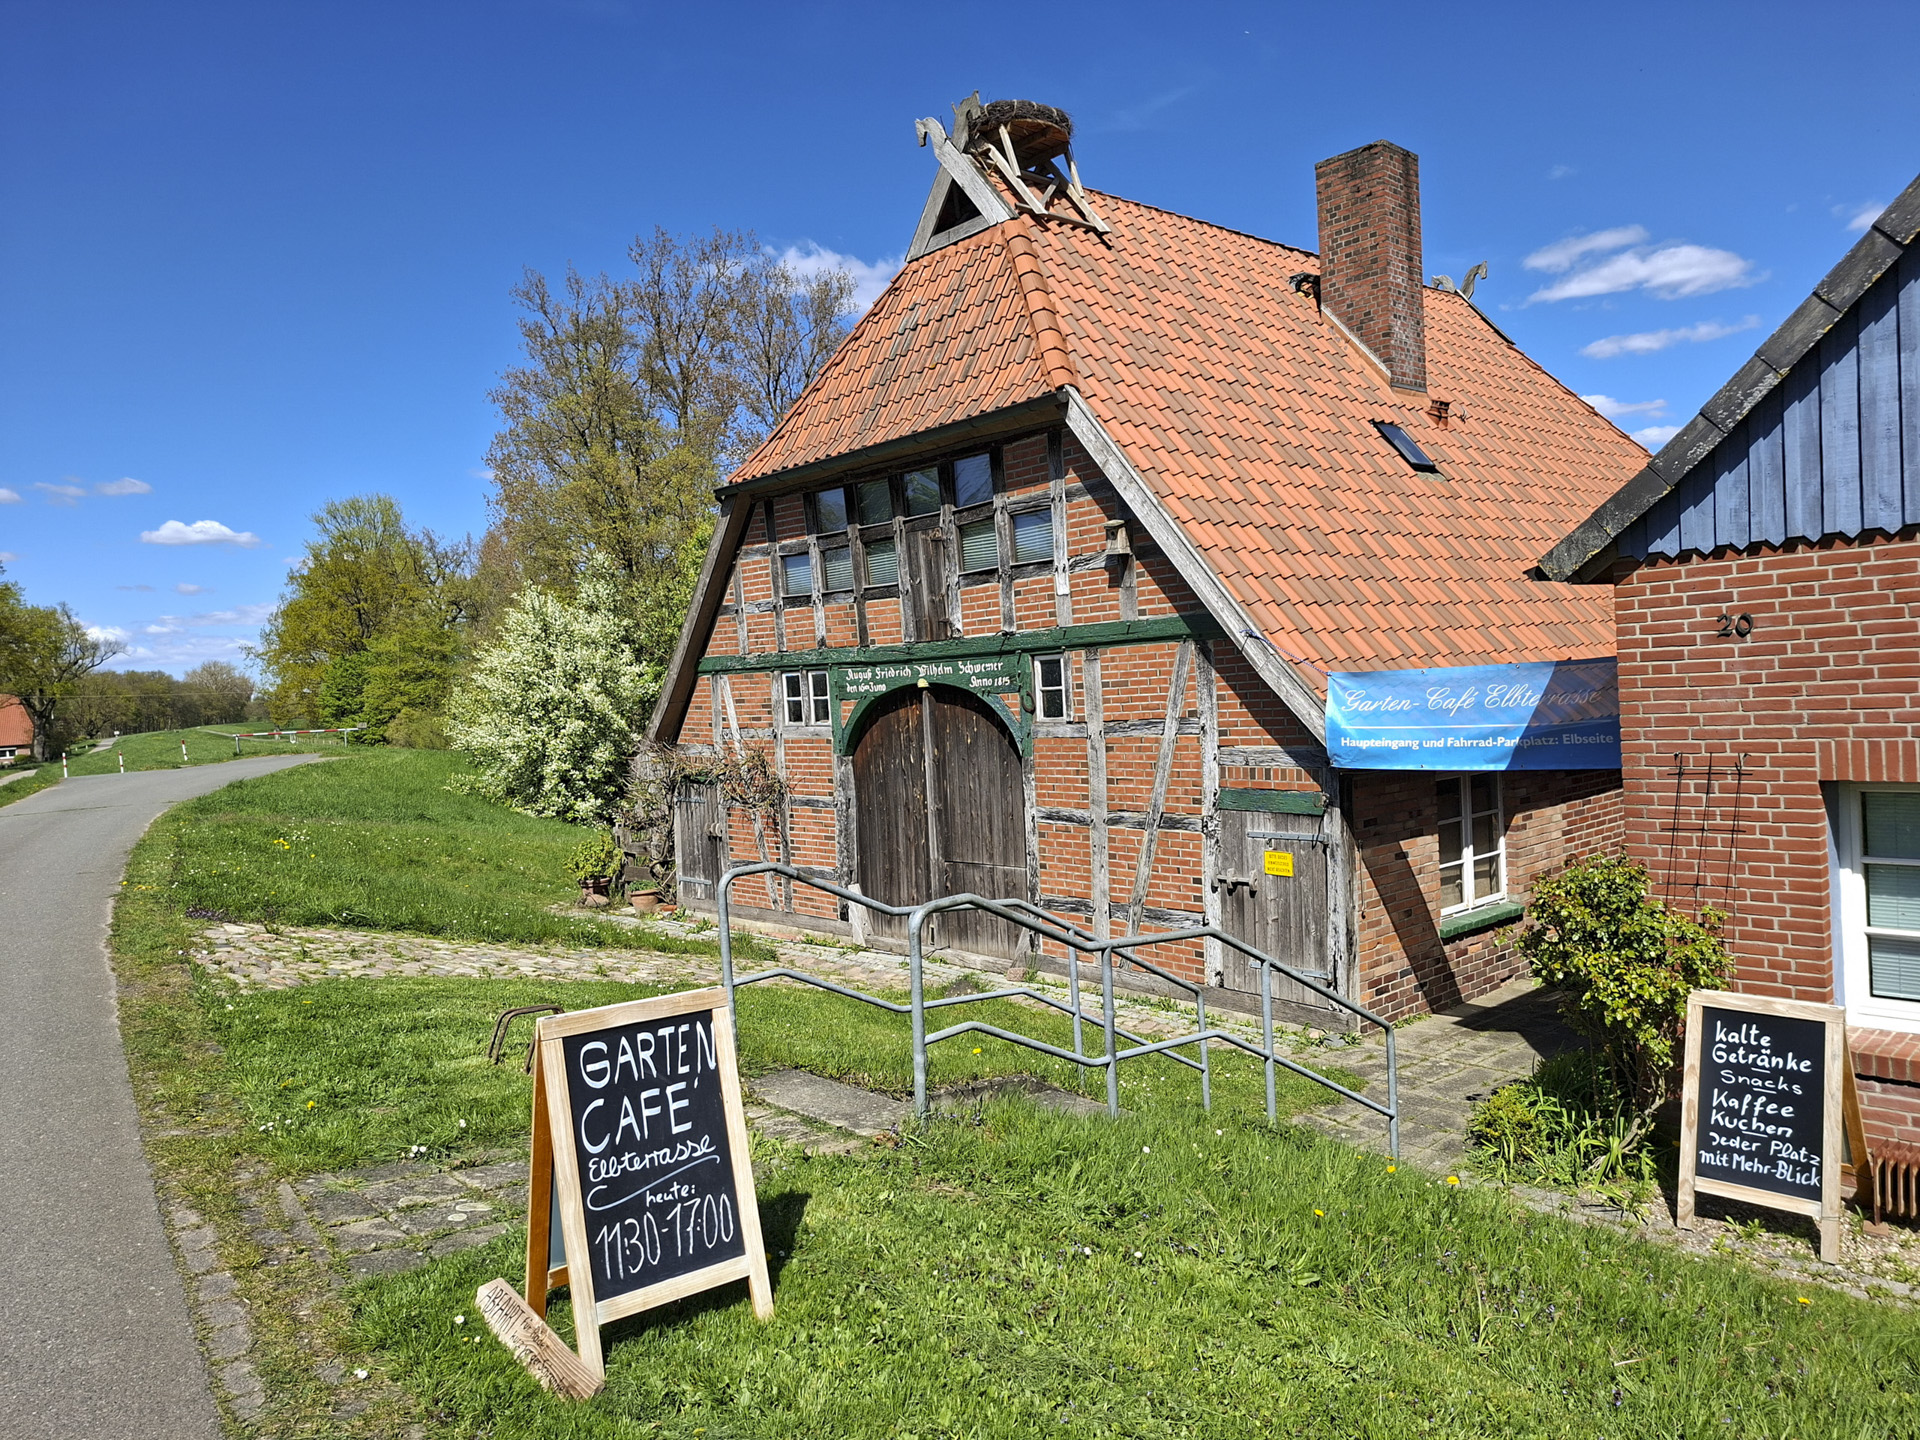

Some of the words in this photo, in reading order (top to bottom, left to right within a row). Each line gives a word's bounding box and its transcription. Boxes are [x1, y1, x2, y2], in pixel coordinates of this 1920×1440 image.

[1716, 612, 1753, 638] 20
[1341, 689, 1420, 712] Garten-
[1426, 686, 1475, 717] Café
[1341, 736, 1419, 750] Haupteingang
[1423, 737, 1444, 747] und
[1447, 735, 1559, 749] Fahrrad-Parkplatz:
[1563, 734, 1613, 744] Elbseite
[1715, 1020, 1771, 1047] kalte
[579, 1020, 717, 1089] GARTEN
[1712, 1045, 1812, 1073] Getränke
[1720, 1070, 1803, 1095] Snacks
[1712, 1088, 1795, 1118] Kaffee
[1711, 1109, 1793, 1137] Kuchen
[588, 1134, 716, 1183] Elbterrasse
[1699, 1150, 1729, 1166] mit
[1709, 1132, 1762, 1151] Jeder
[1770, 1141, 1821, 1166] Platz
[480, 1285, 525, 1335] ABFAHRT
